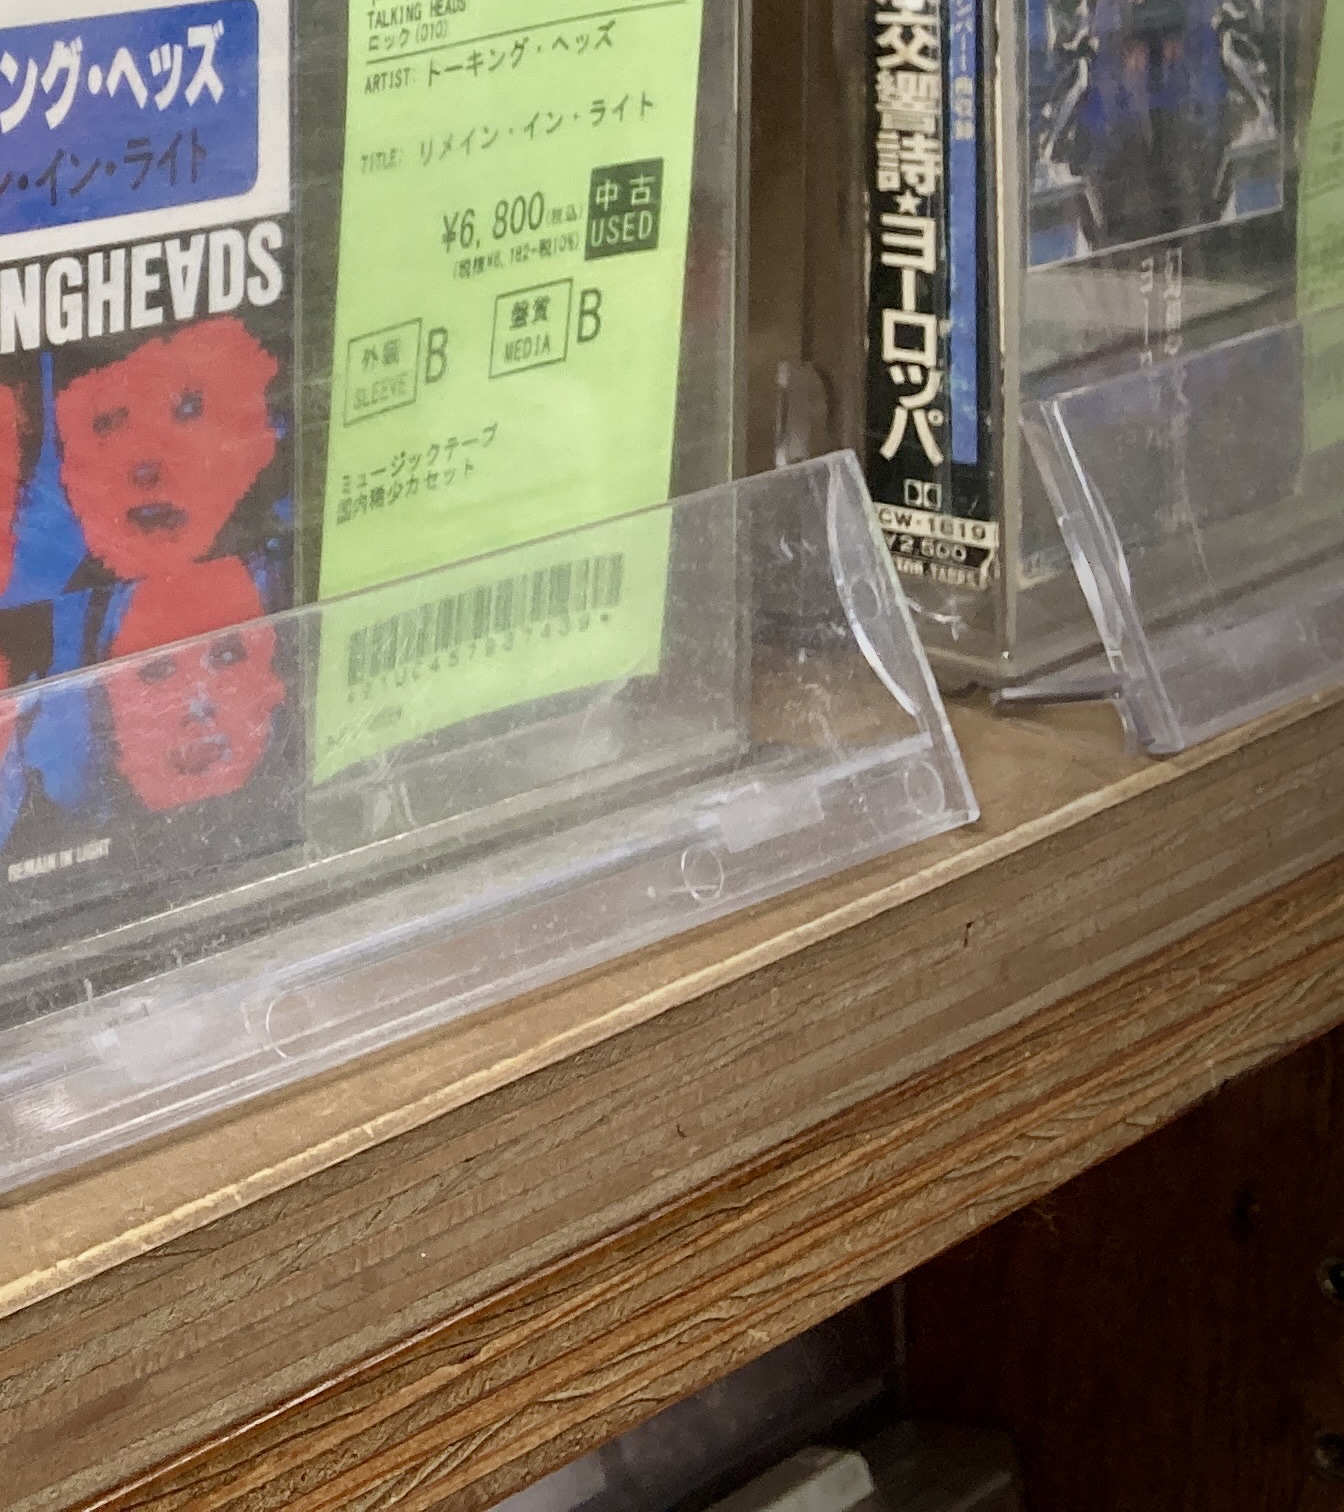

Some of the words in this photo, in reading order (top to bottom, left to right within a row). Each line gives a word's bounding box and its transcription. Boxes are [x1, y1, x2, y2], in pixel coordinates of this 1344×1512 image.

[367, 2, 422, 31] TALKING
[427, 19, 616, 88] トーキング・ヘッズ
[418, 90, 657, 168] リメイン・イン・ライト
[596, 173, 655, 212] 中古
[591, 211, 654, 248] USED
[576, 286, 603, 345] B
[425, 326, 449, 385] B
[502, 331, 552, 365] MEDIA
